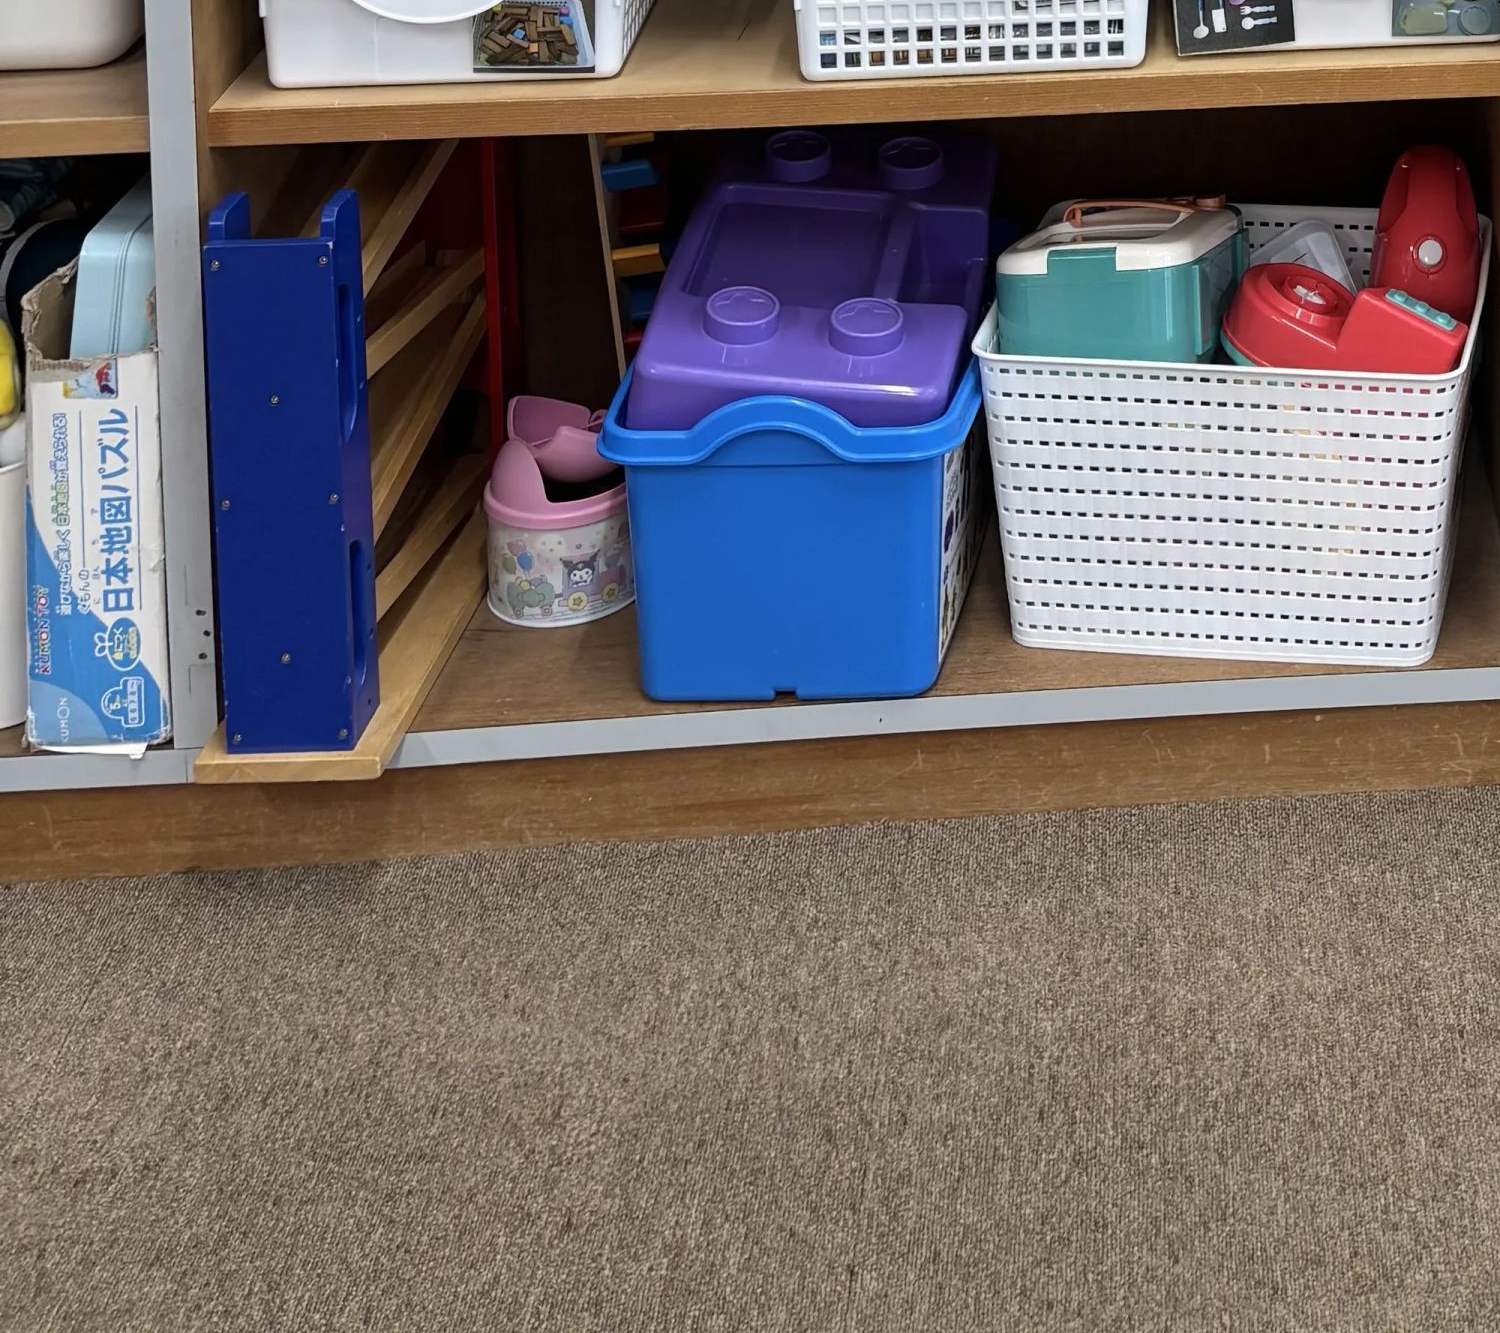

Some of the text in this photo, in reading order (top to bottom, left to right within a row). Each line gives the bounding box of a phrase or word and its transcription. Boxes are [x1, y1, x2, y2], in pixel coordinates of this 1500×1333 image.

[97, 408, 135, 613] 日本地図パズル
[36, 585, 51, 675] KUMON TOY
